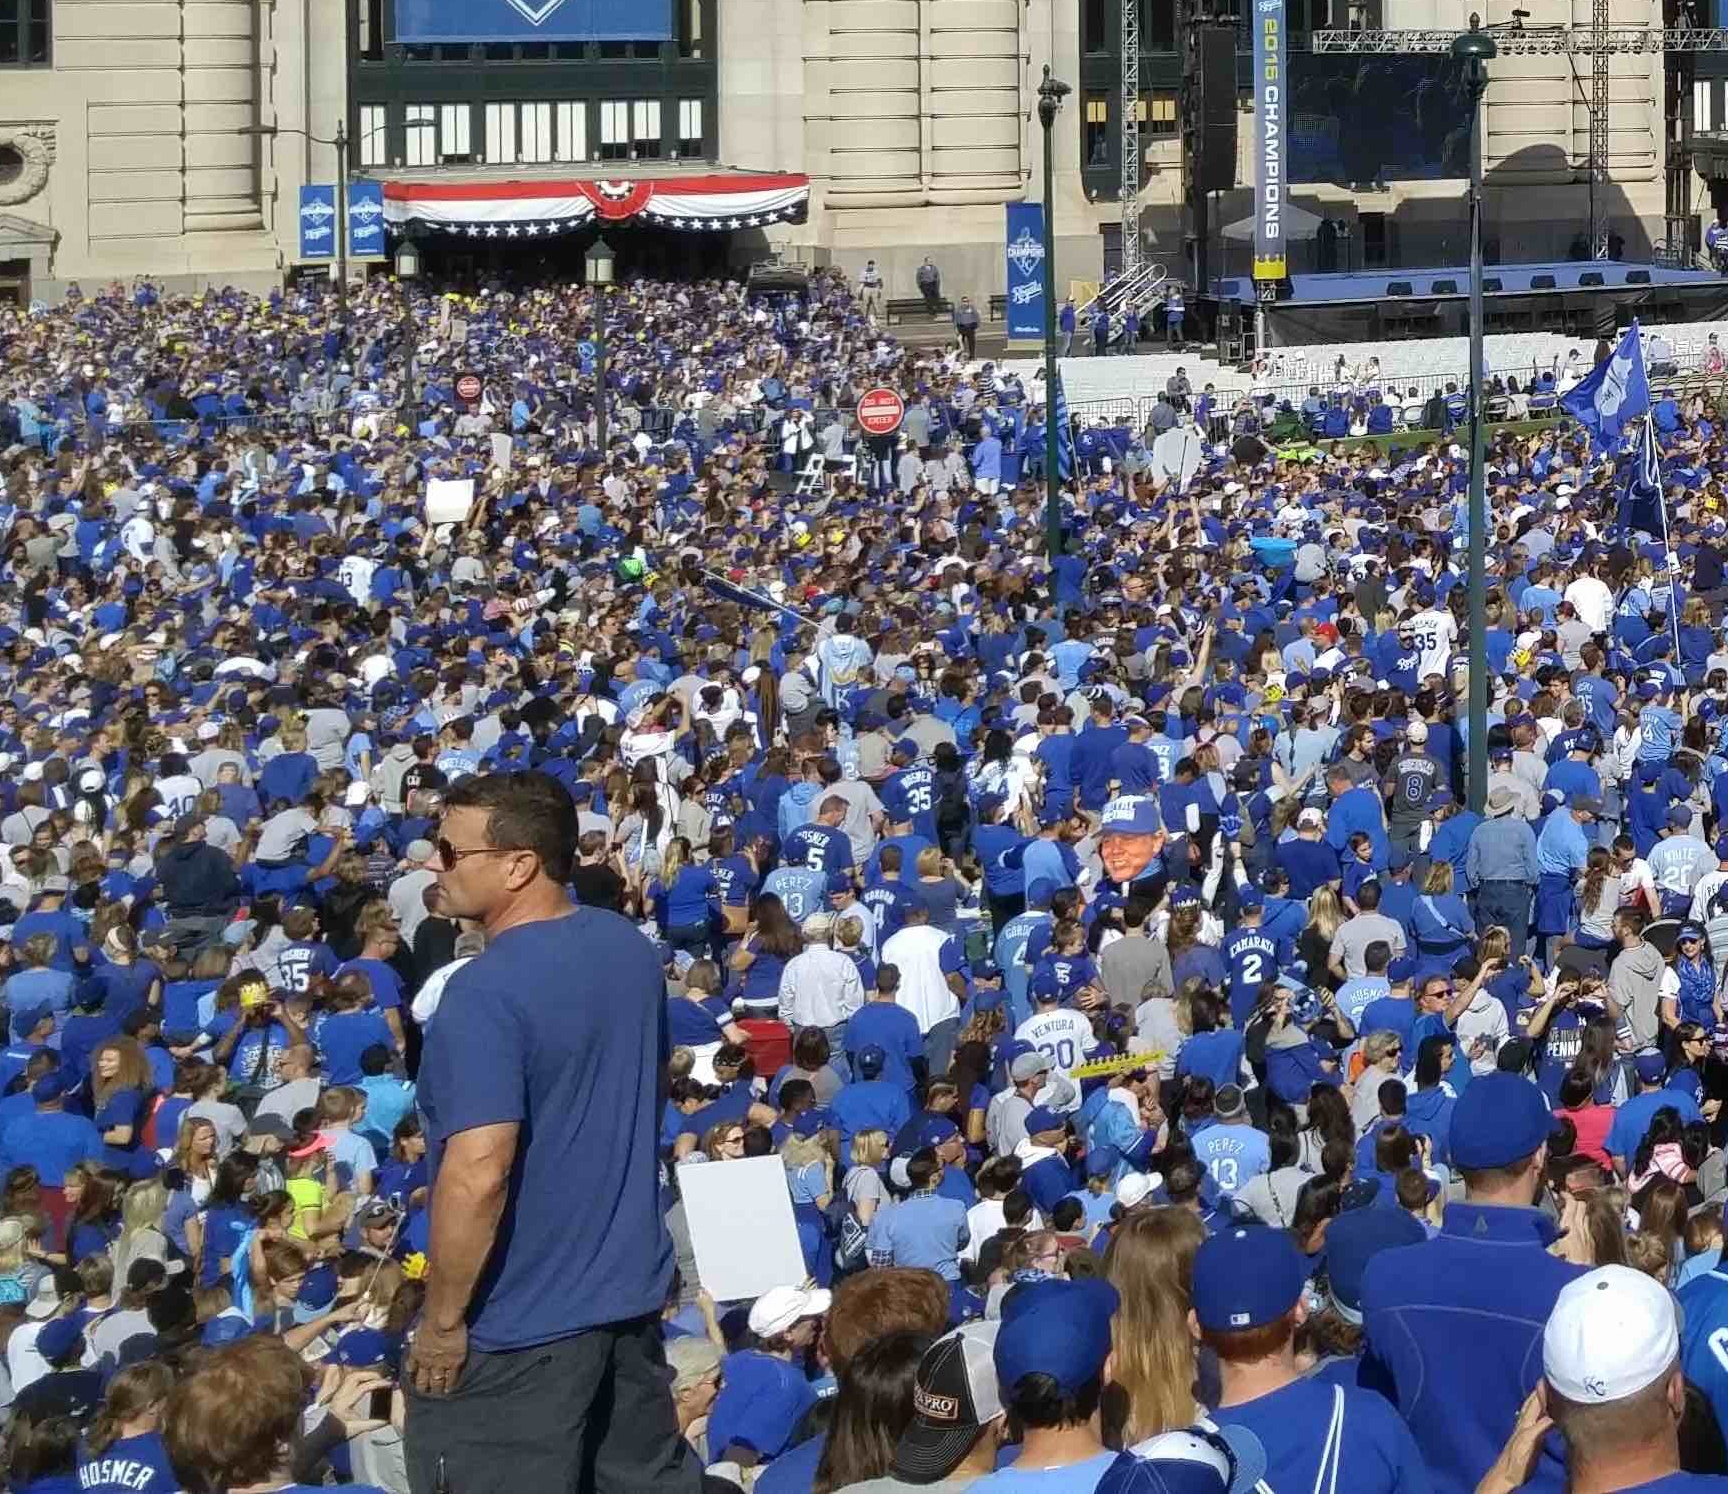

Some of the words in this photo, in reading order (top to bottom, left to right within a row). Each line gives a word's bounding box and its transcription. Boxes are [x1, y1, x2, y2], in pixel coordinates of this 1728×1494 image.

[1264, 18, 1279, 80] 2015
[1265, 85, 1279, 240] CHAMPIONS
[868, 417, 892, 425] ENTER
[1413, 633, 1437, 651] 35
[907, 785, 931, 814] 35
[1407, 774, 1424, 801] 8
[171, 797, 194, 817] 40
[1659, 848, 1696, 862] WHITE
[775, 877, 812, 892] PEREZ
[782, 892, 803, 916] 13
[873, 903, 885, 930] 4
[1012, 941, 1028, 967] 4
[280, 962, 309, 992] 35
[1242, 954, 1262, 985] 2
[1031, 1017, 1075, 1040] VENTURA
[1208, 1138, 1245, 1153] PEREZ
[1211, 1157, 1240, 1190] 13
[1583, 1376, 1605, 1396] KC
[79, 1459, 155, 1491] HOSMER
